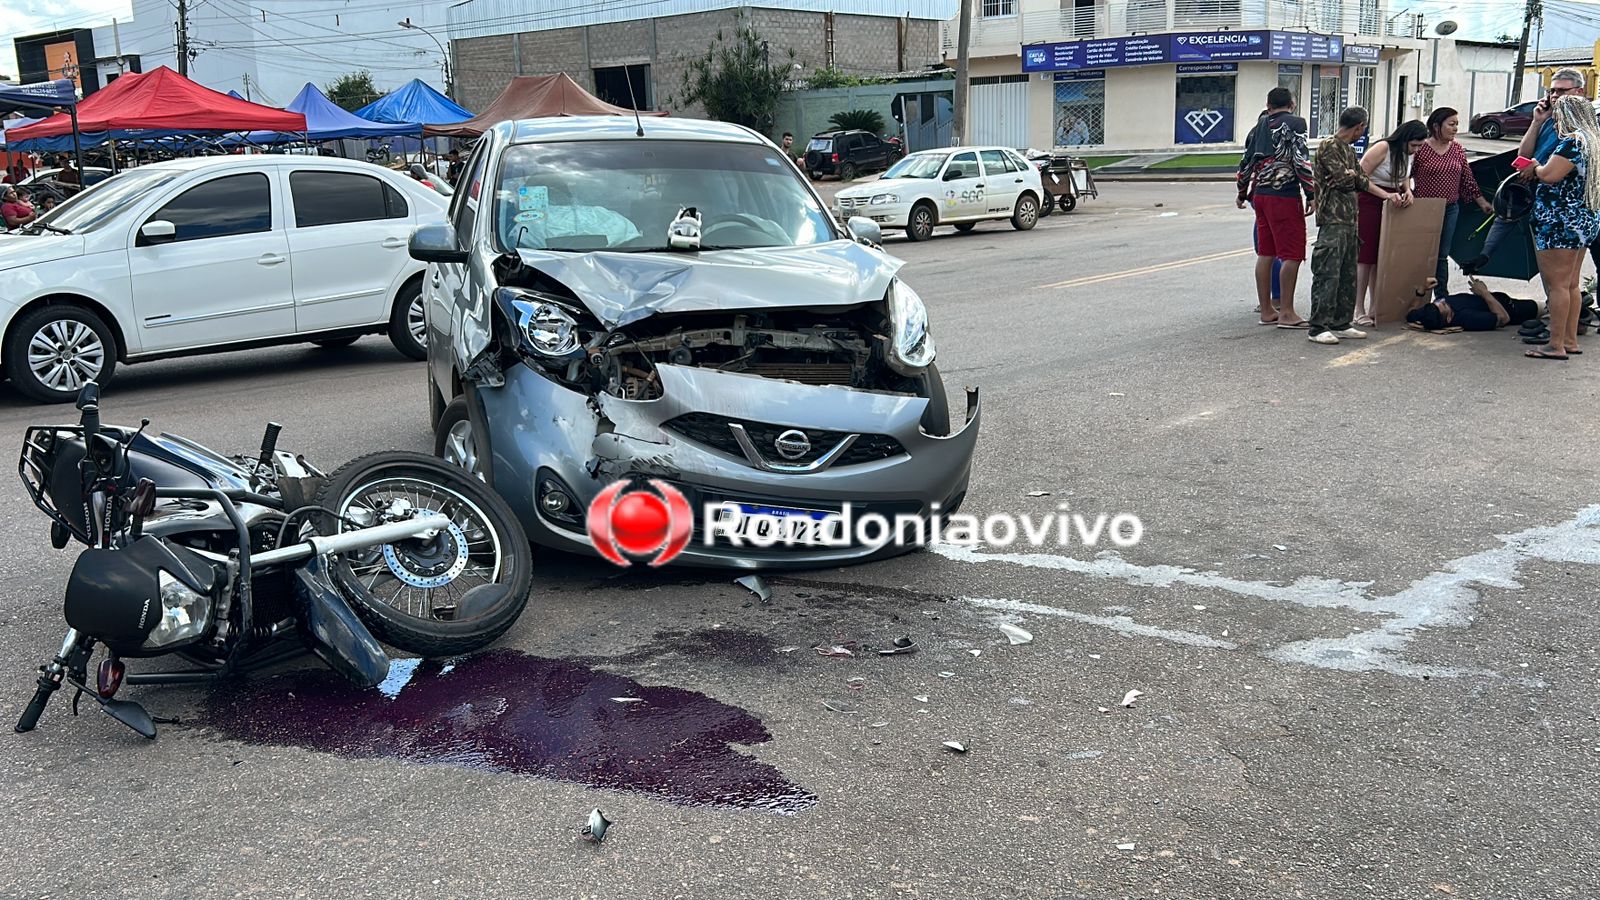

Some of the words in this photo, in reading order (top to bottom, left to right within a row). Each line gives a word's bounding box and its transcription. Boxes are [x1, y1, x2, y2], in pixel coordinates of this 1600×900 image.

[1189, 35, 1248, 45] EXCELENCIA
[961, 190, 984, 203] SGC
[779, 442, 807, 450] NISSAN
[83, 501, 92, 540] HONDA
[104, 496, 113, 532] HONDA
[138, 598, 150, 629] HONDA
